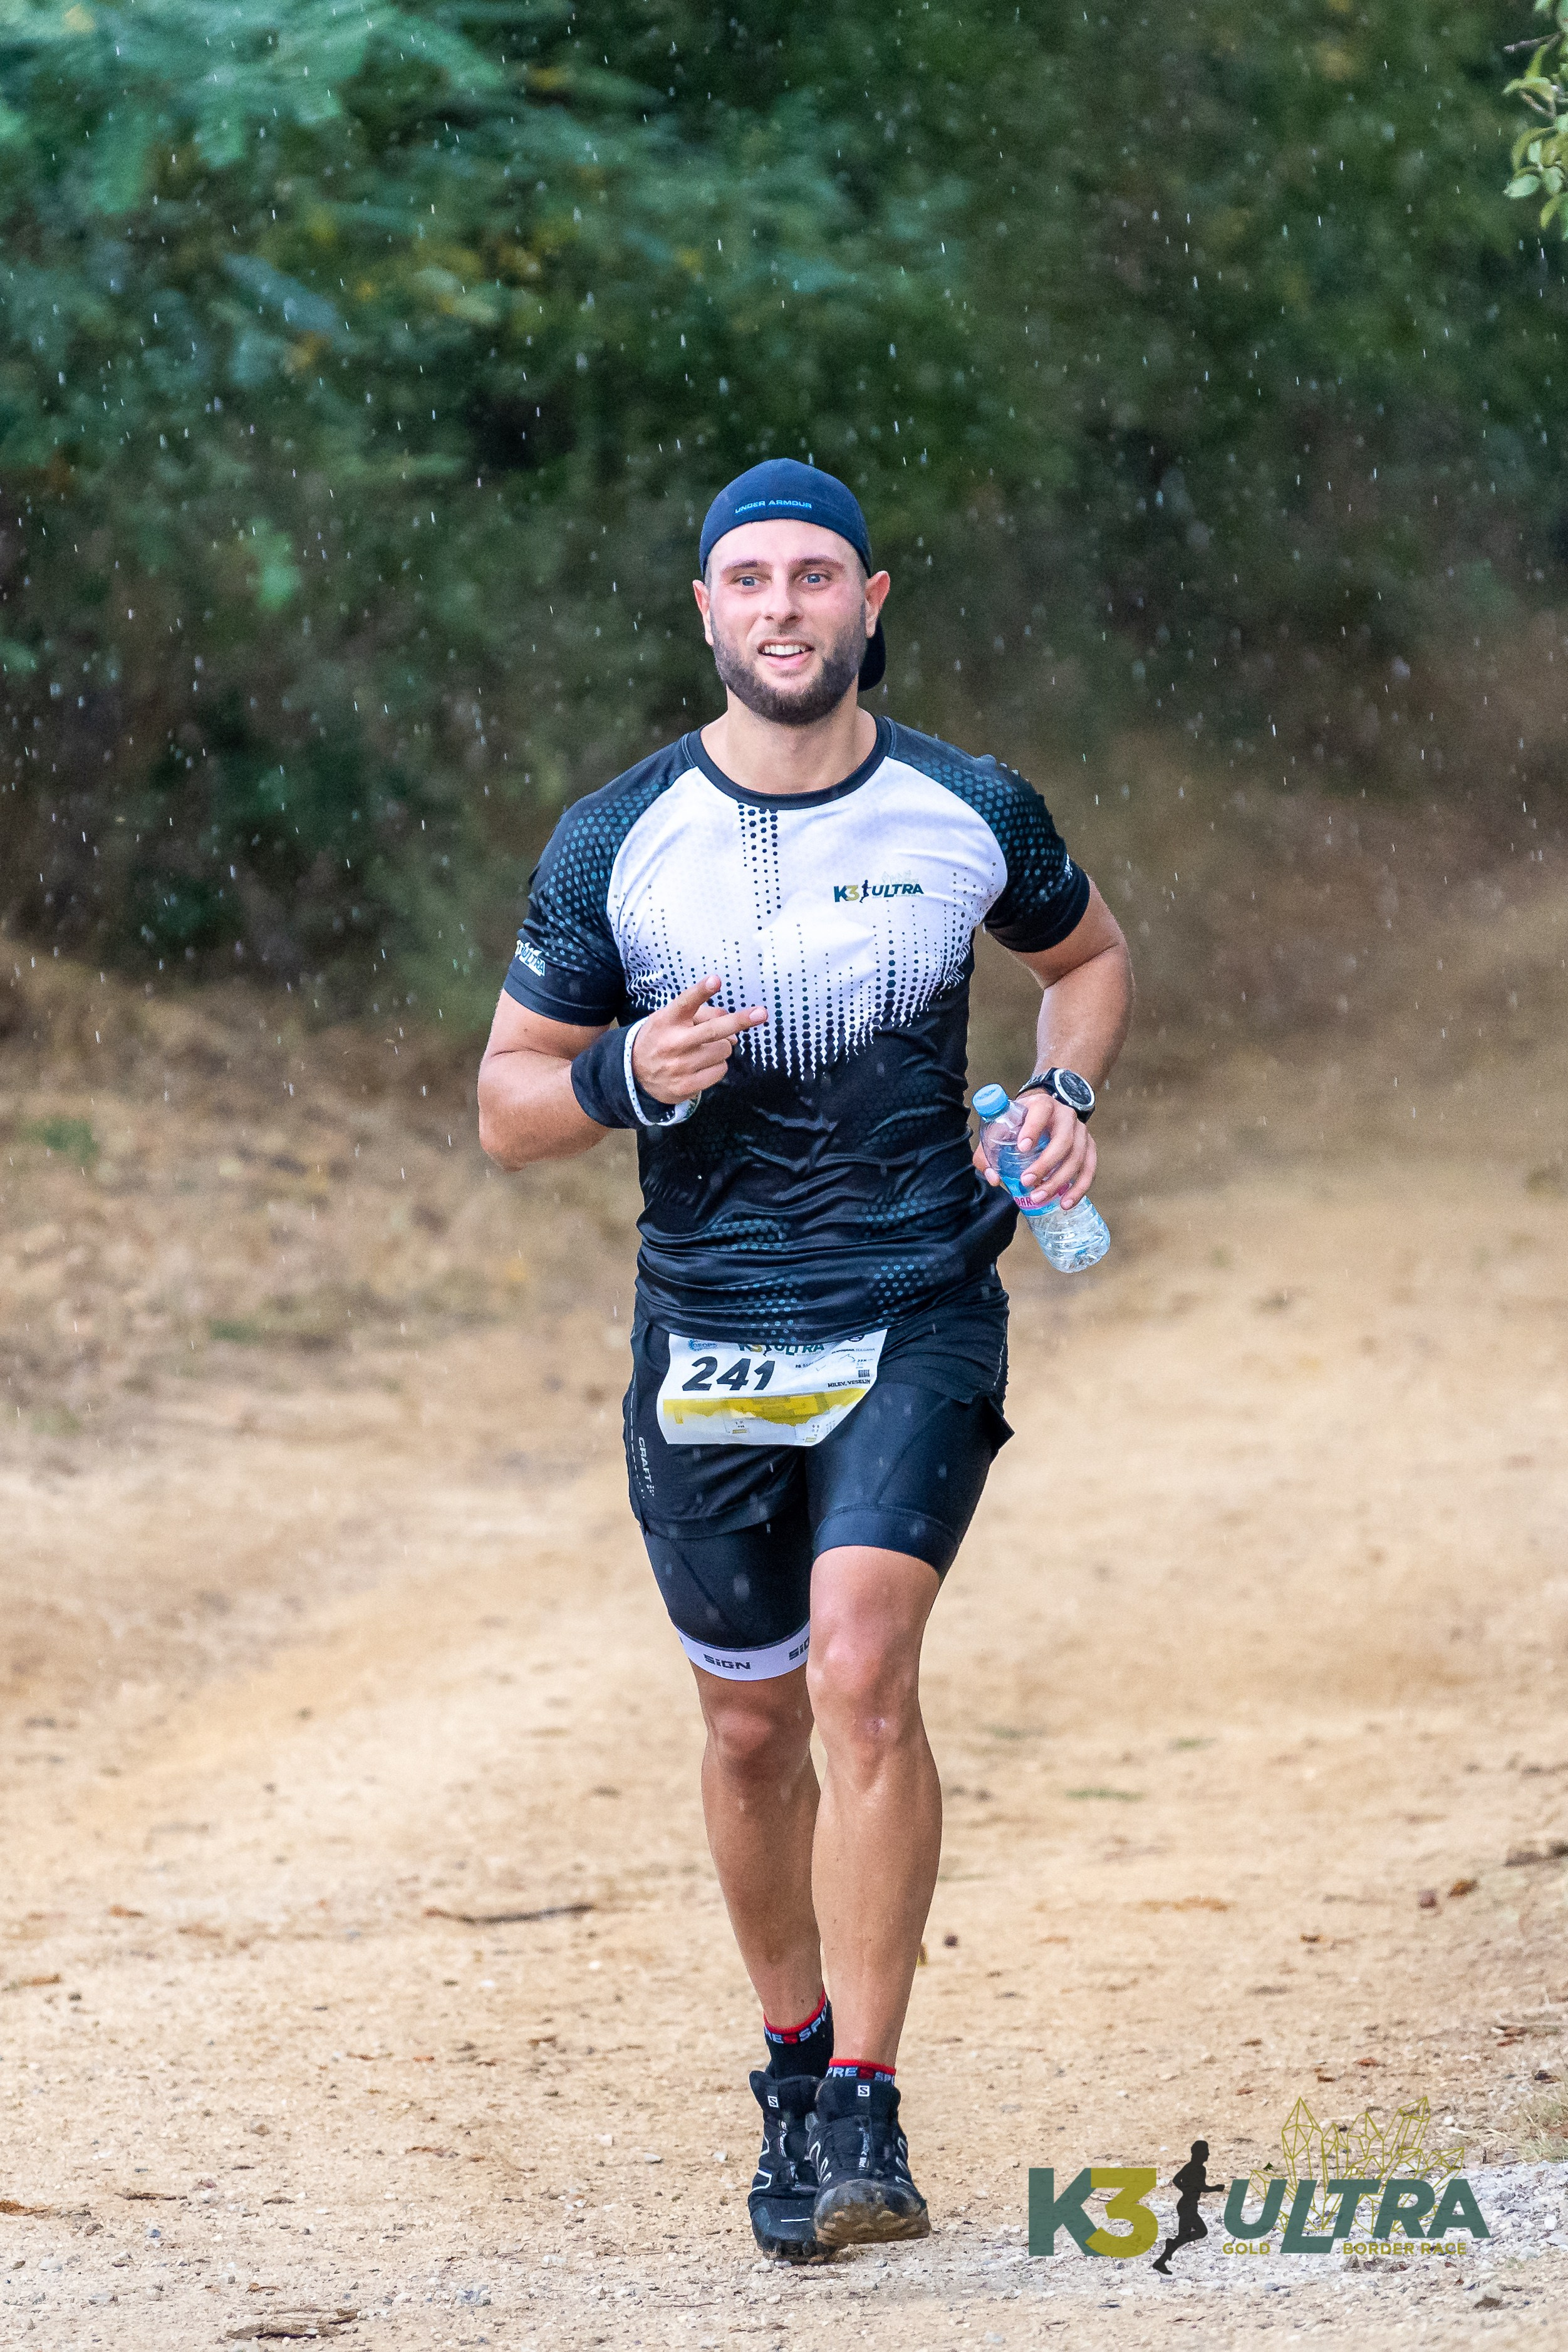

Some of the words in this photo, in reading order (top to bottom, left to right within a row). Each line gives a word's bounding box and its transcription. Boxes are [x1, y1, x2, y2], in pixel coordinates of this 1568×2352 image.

[735, 501, 766, 514] UNDER
[769, 499, 812, 509] ARMOUR
[833, 885, 859, 902] K3
[871, 883, 924, 898] ULTRA
[682, 1356, 775, 1392] 241
[639, 1437, 652, 1483] CRAFT
[858, 2086, 869, 2096] S
[769, 2096, 778, 2107] S
